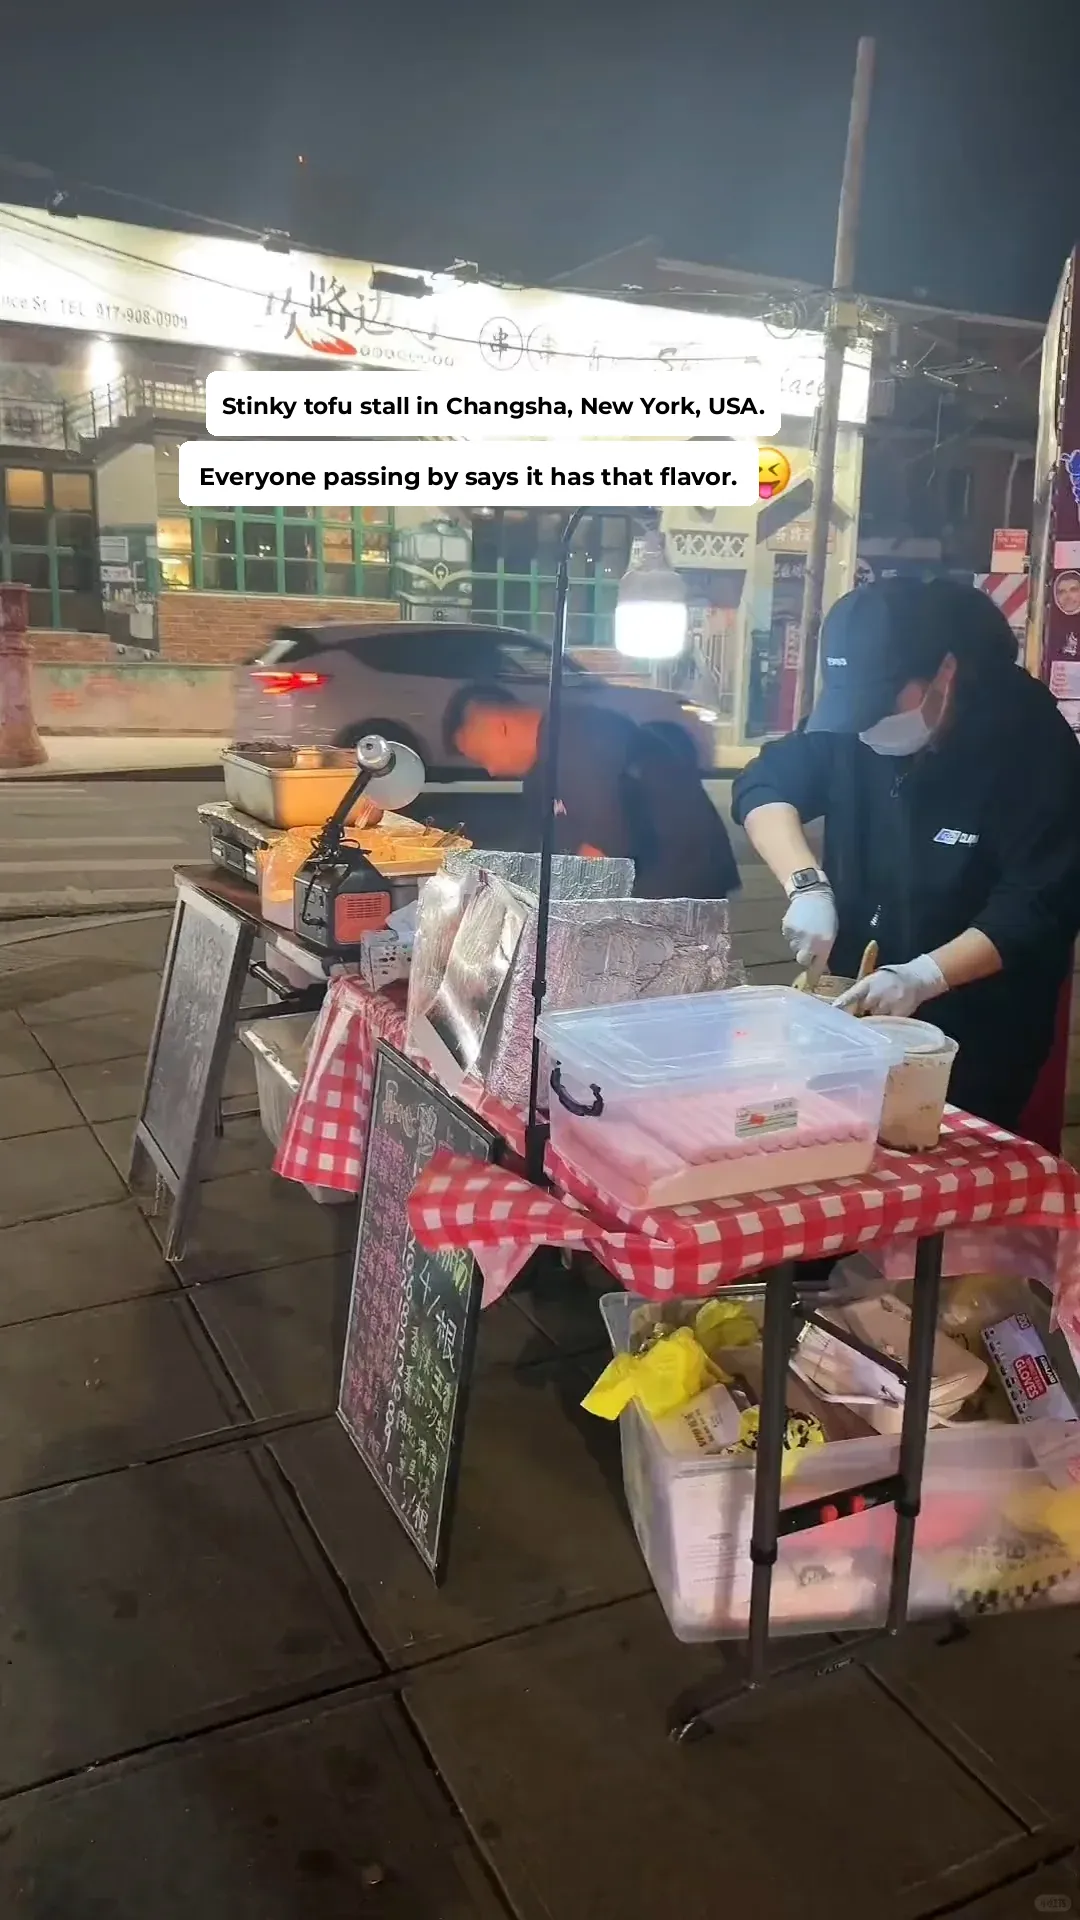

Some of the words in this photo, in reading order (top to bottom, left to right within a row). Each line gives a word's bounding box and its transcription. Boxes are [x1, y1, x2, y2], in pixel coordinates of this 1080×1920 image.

[397, 1296, 409, 1328] 18
[395, 1323, 405, 1353] 12
[1015, 1359, 1039, 1399] GLOVES
